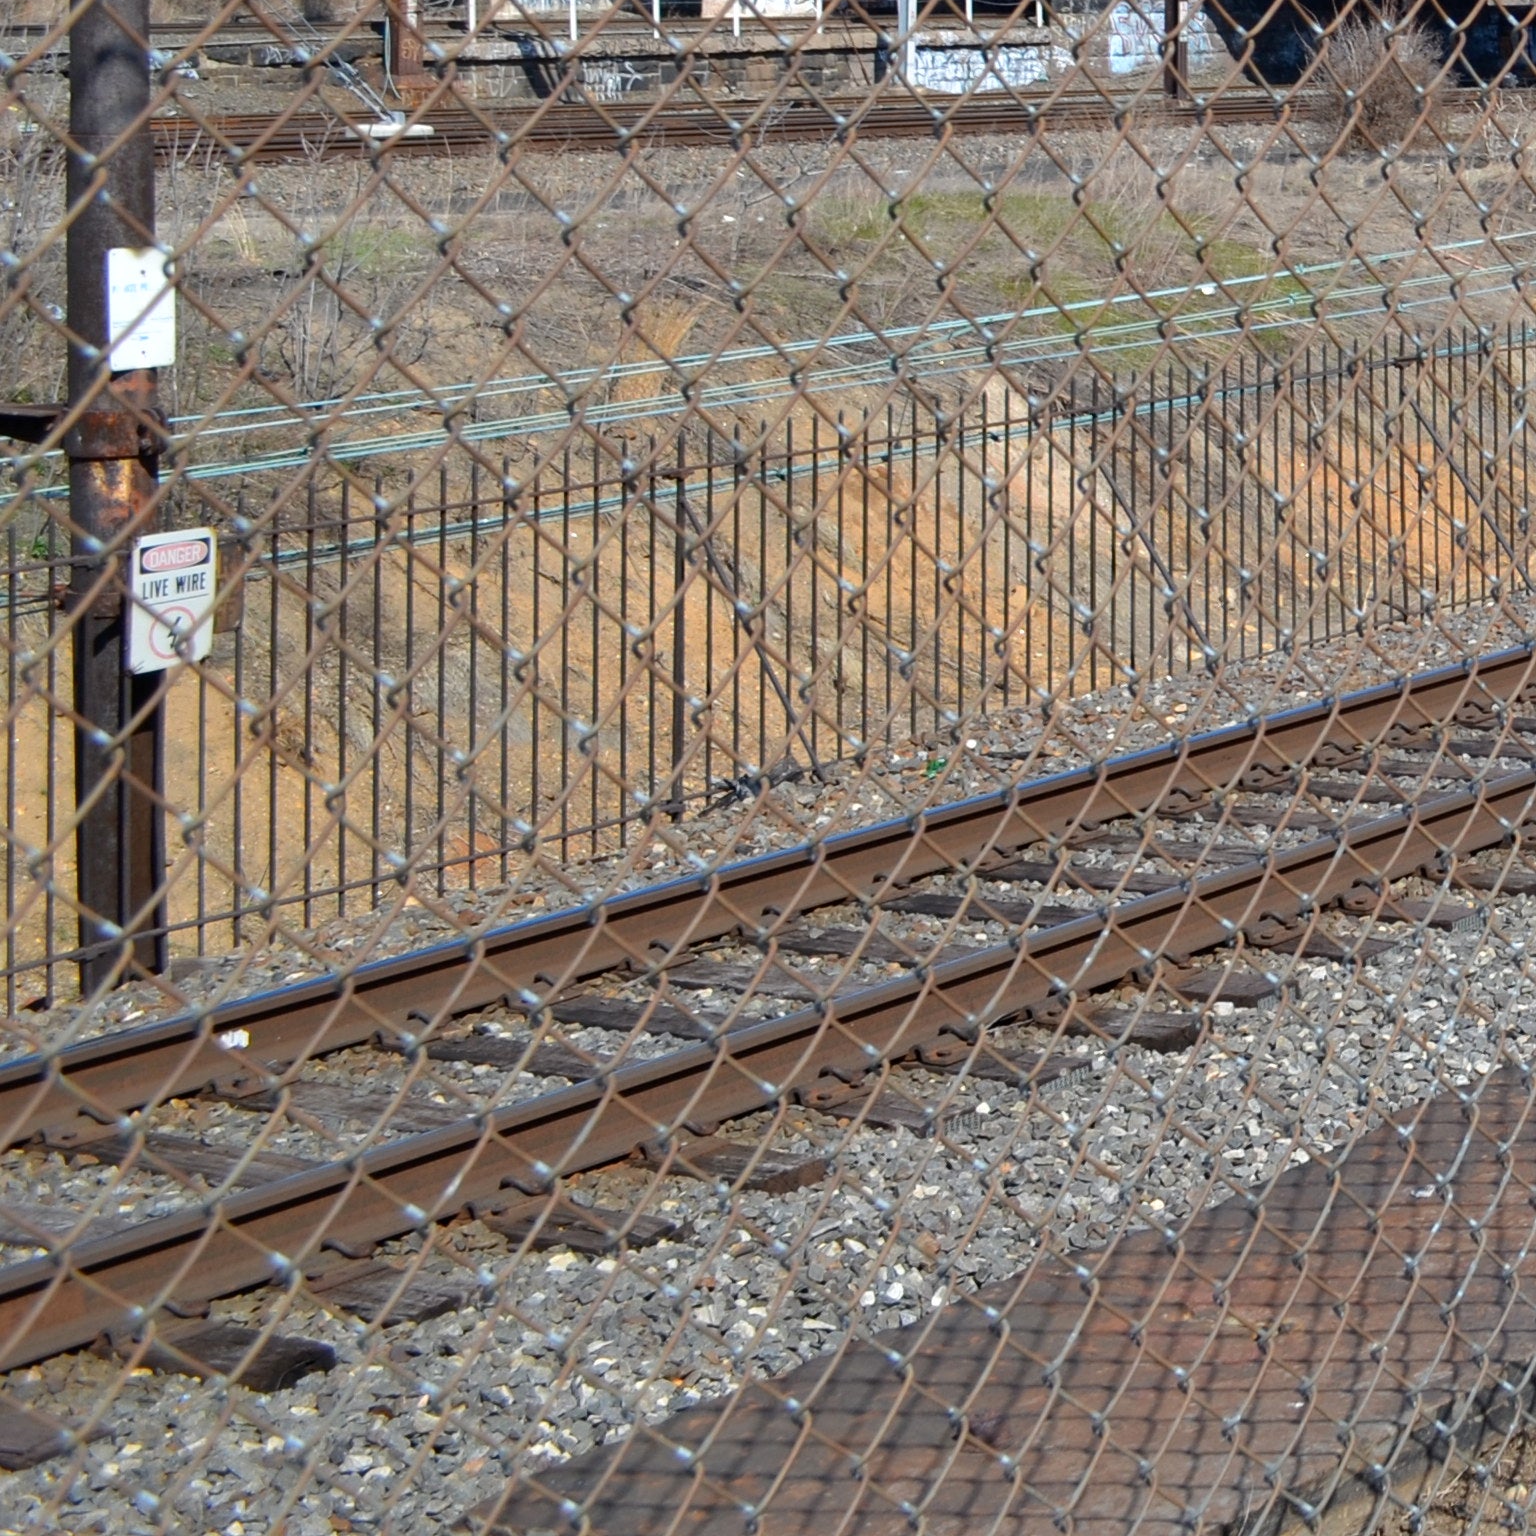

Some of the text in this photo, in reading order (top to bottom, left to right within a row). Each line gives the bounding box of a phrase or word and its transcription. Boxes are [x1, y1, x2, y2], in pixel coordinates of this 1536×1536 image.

[150, 544, 201, 568] DANGER
[142, 571, 207, 600] LIVE WIRE
